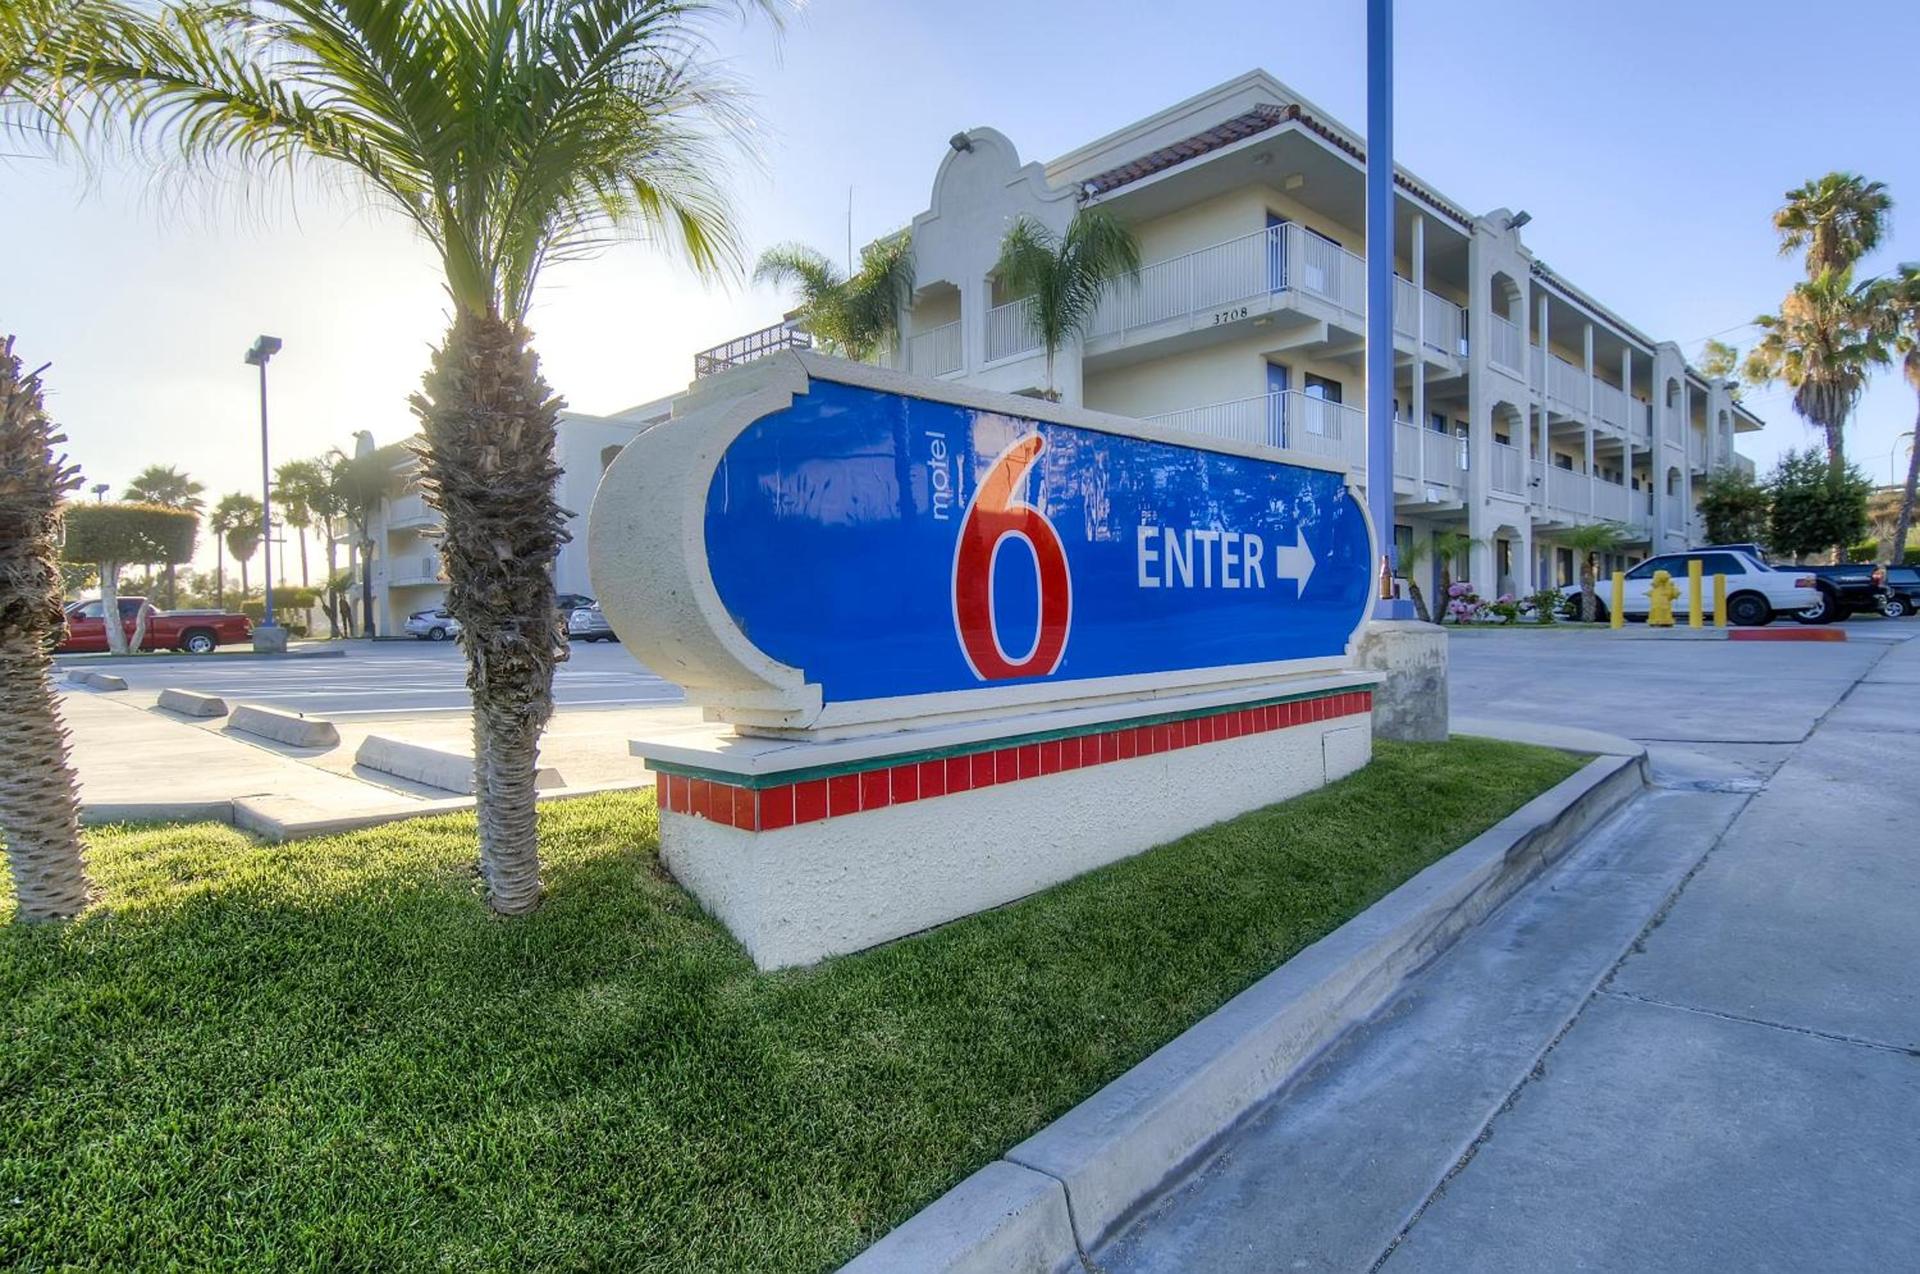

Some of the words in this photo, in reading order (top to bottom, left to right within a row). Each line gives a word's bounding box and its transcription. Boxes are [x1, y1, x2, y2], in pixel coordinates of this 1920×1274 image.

[1214, 306, 1248, 325] 3708
[925, 431, 949, 520] motel
[951, 431, 1073, 681] 6
[1137, 525, 1265, 588] ENTER
